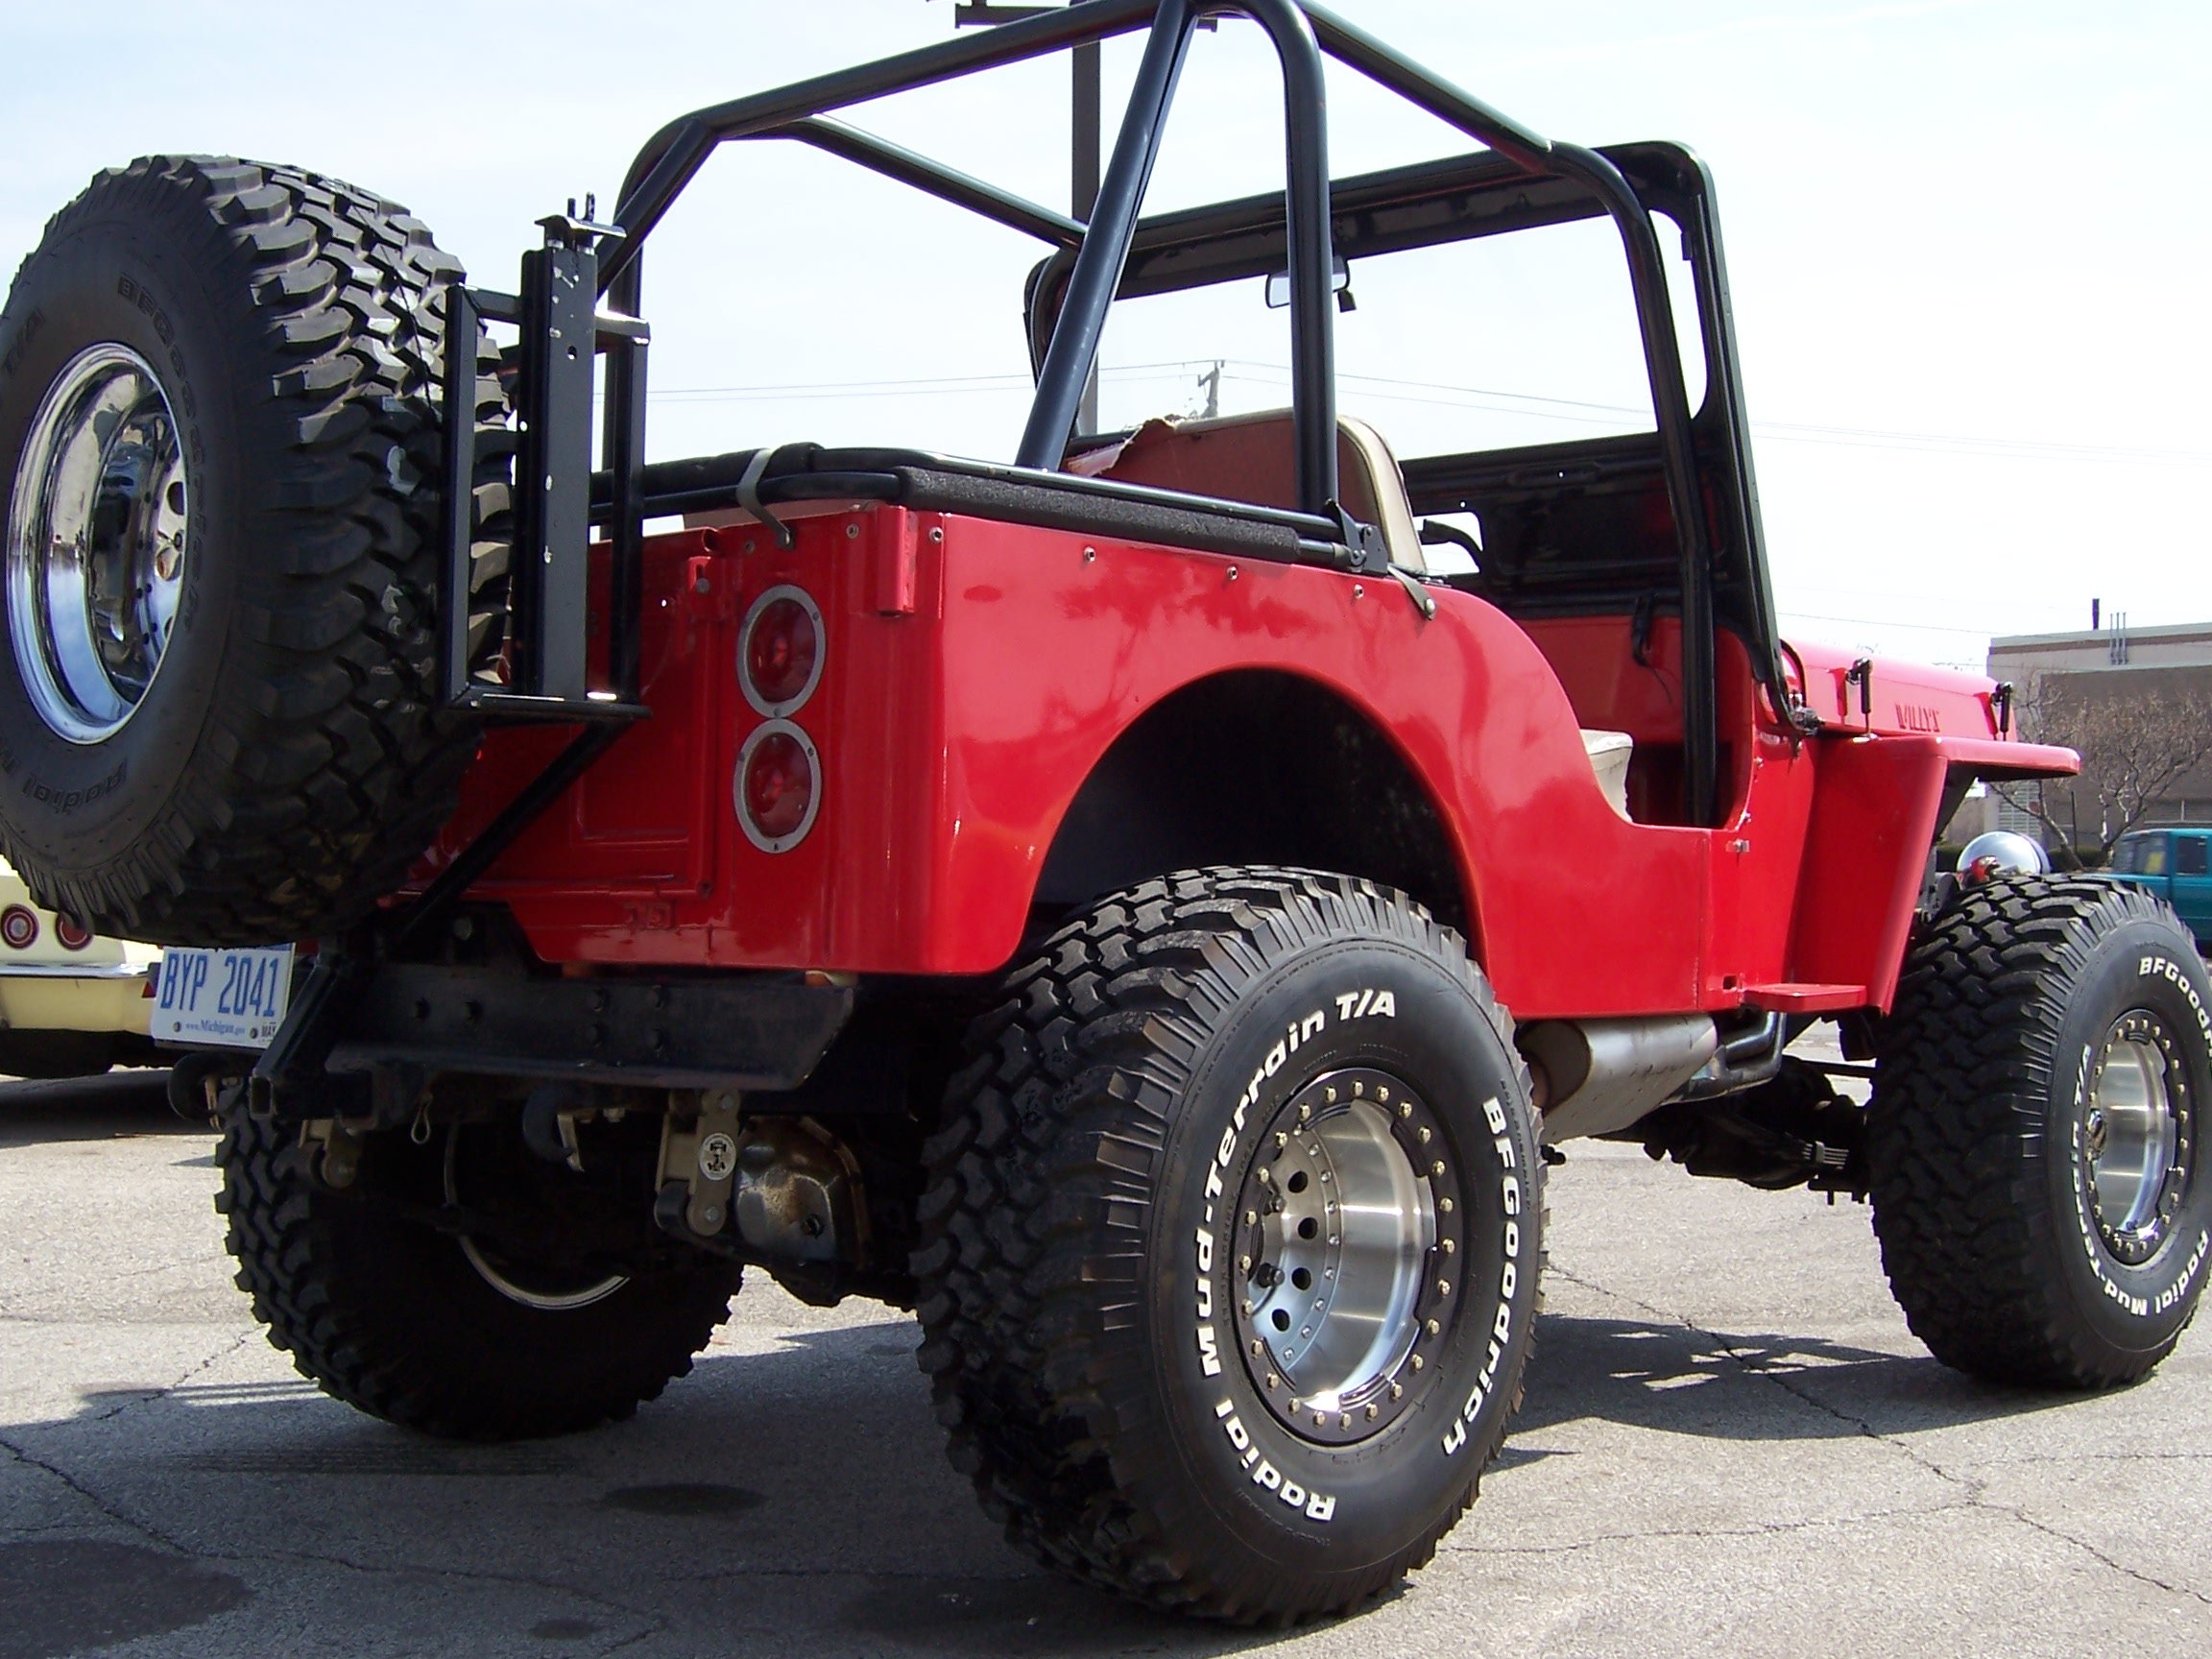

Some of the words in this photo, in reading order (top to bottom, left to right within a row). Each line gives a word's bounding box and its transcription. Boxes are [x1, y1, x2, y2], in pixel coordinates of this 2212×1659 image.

[1895, 704, 1941, 733] WILLYS
[23, 755, 129, 815] Radial
[159, 951, 210, 1012] BYP
[217, 954, 278, 1018] 2041
[1335, 990, 1396, 1021] T/A
[1195, 1004, 1325, 1377] Mud-Terrain
[2071, 1119, 2148, 1316] Mud-Terrain
[1442, 1096, 1521, 1456] BFGoodrich
[2155, 1230, 2208, 1313] Radial
[1214, 1399, 1337, 1523] Radial
